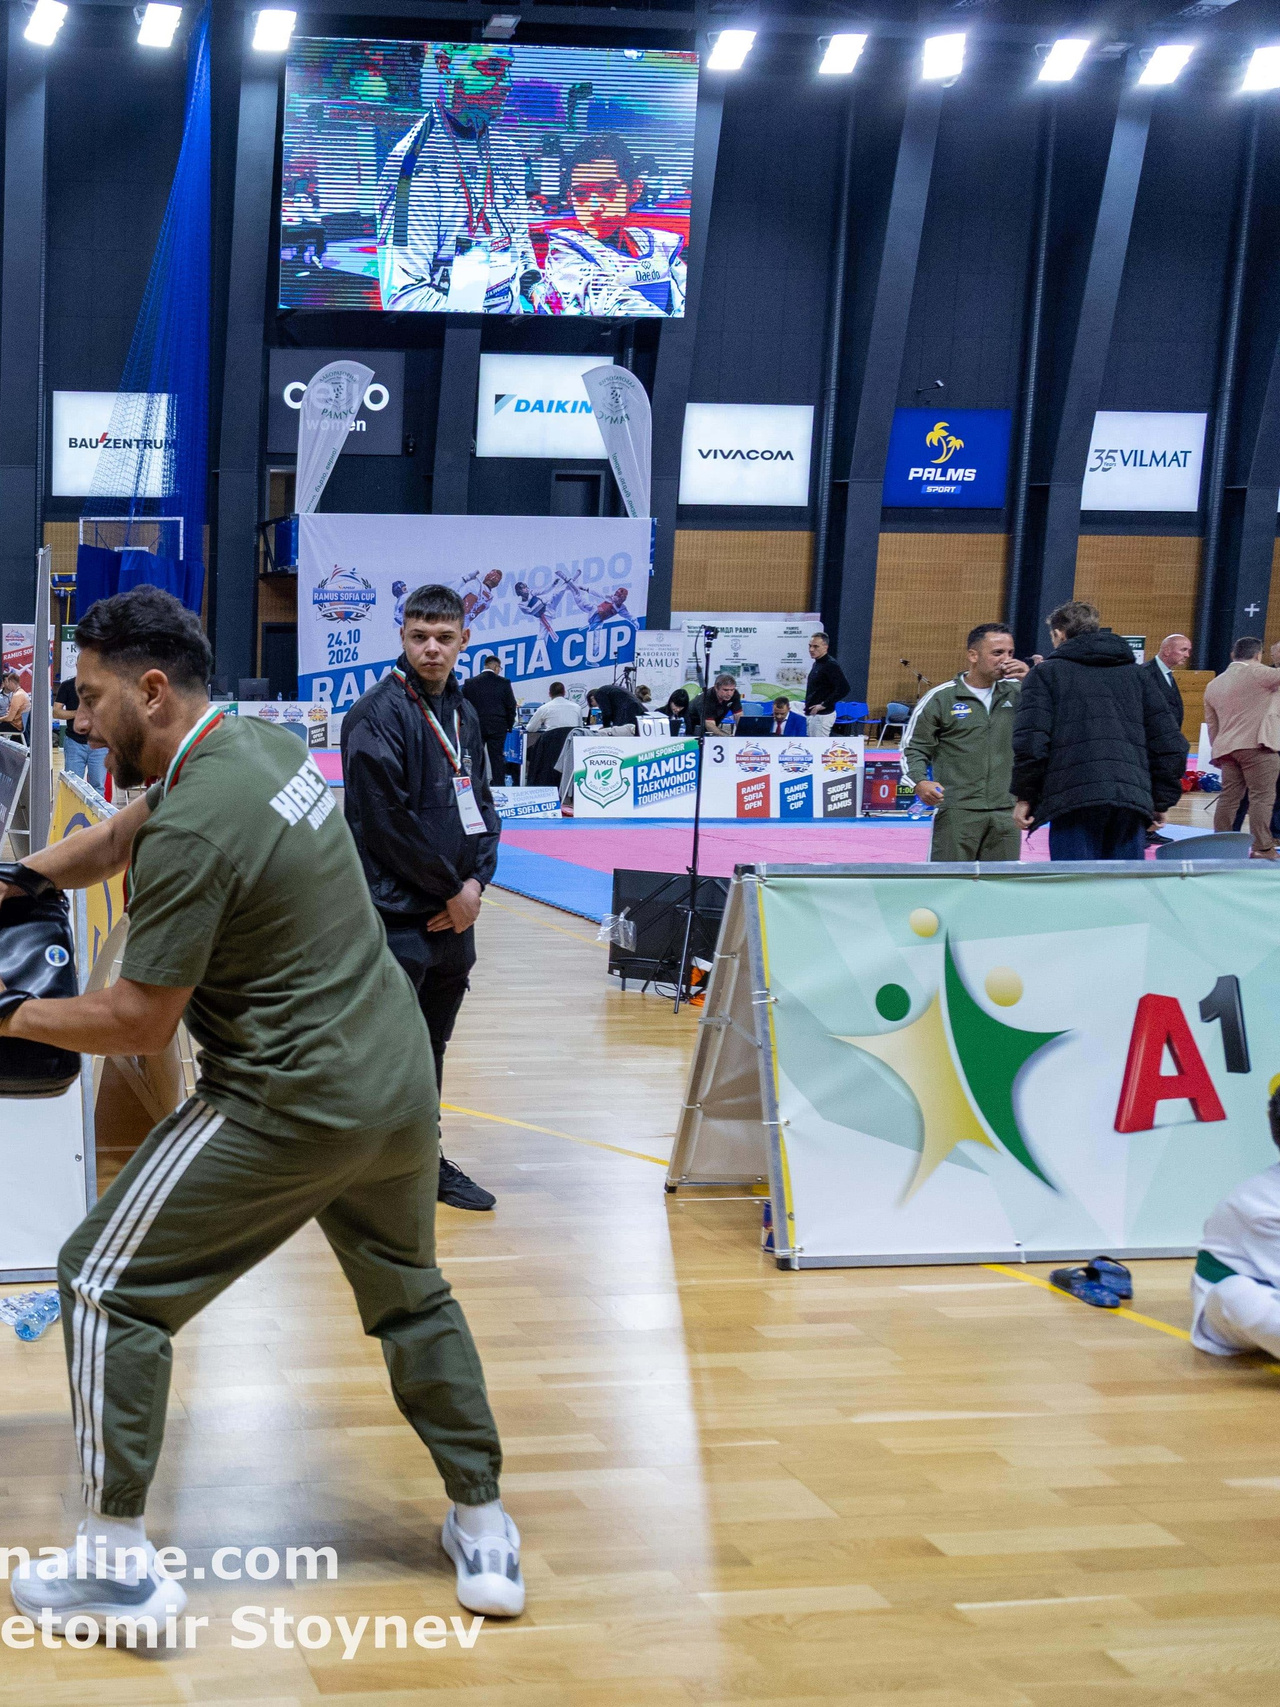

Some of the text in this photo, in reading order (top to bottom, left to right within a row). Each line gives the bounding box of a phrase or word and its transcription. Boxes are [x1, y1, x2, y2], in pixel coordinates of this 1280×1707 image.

[321, 407, 356, 420] РАМУС
[514, 399, 593, 414] DAIKIN
[697, 448, 794, 461] VIVACOM
[1089, 448, 1118, 472] 35
[1119, 449, 1192, 468] VILMAT
[908, 467, 977, 482] PALMS
[926, 485, 956, 493] SPORT
[314, 592, 375, 601] RAMUS SOFIA CUP
[327, 628, 361, 649] 24.10
[3, 647, 34, 661] RAMUS SOF
[328, 646, 359, 666] 2026
[312, 624, 633, 707] RAM SOFIA CUP
[638, 658, 680, 667] RAMUS
[638, 743, 685, 762] MAIN SPONSOR
[713, 745, 725, 763] 3
[637, 752, 696, 783] RAMUS
[637, 770, 696, 795] TAEKWONDO
[741, 782, 765, 794] RAMUS
[784, 782, 808, 794] RAMUS
[827, 781, 852, 794] SKOPJE
[637, 783, 696, 806] TOURNAMENTS
[743, 791, 763, 802] SOFIA
[787, 791, 806, 802] SOFIA
[830, 791, 849, 802] OPEN
[880, 784, 889, 798] 0
[899, 786, 914, 794] 1:00
[498, 809, 516, 817] MUS
[517, 805, 540, 815] SOFIA
[541, 802, 557, 811] CUP
[744, 800, 762, 811] OPEN
[790, 801, 803, 810] CUP
[827, 800, 852, 812] RAMUS
[1113, 974, 1252, 1134] A1
